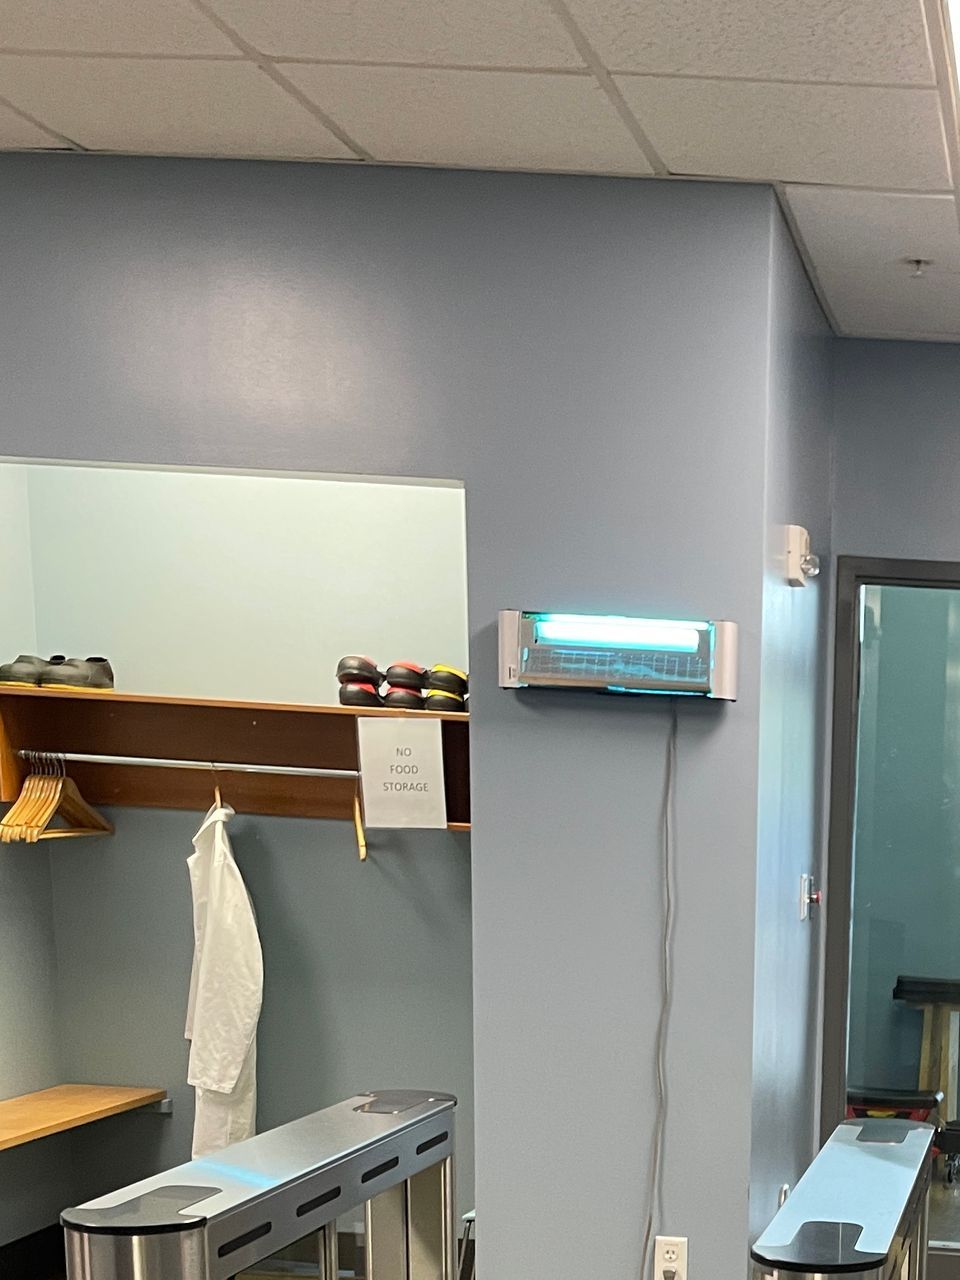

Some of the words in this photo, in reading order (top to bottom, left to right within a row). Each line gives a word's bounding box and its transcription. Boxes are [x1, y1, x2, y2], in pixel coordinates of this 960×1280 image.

[396, 747, 412, 757] NO
[390, 764, 419, 775] FOOD
[383, 782, 429, 792] STORAGE
